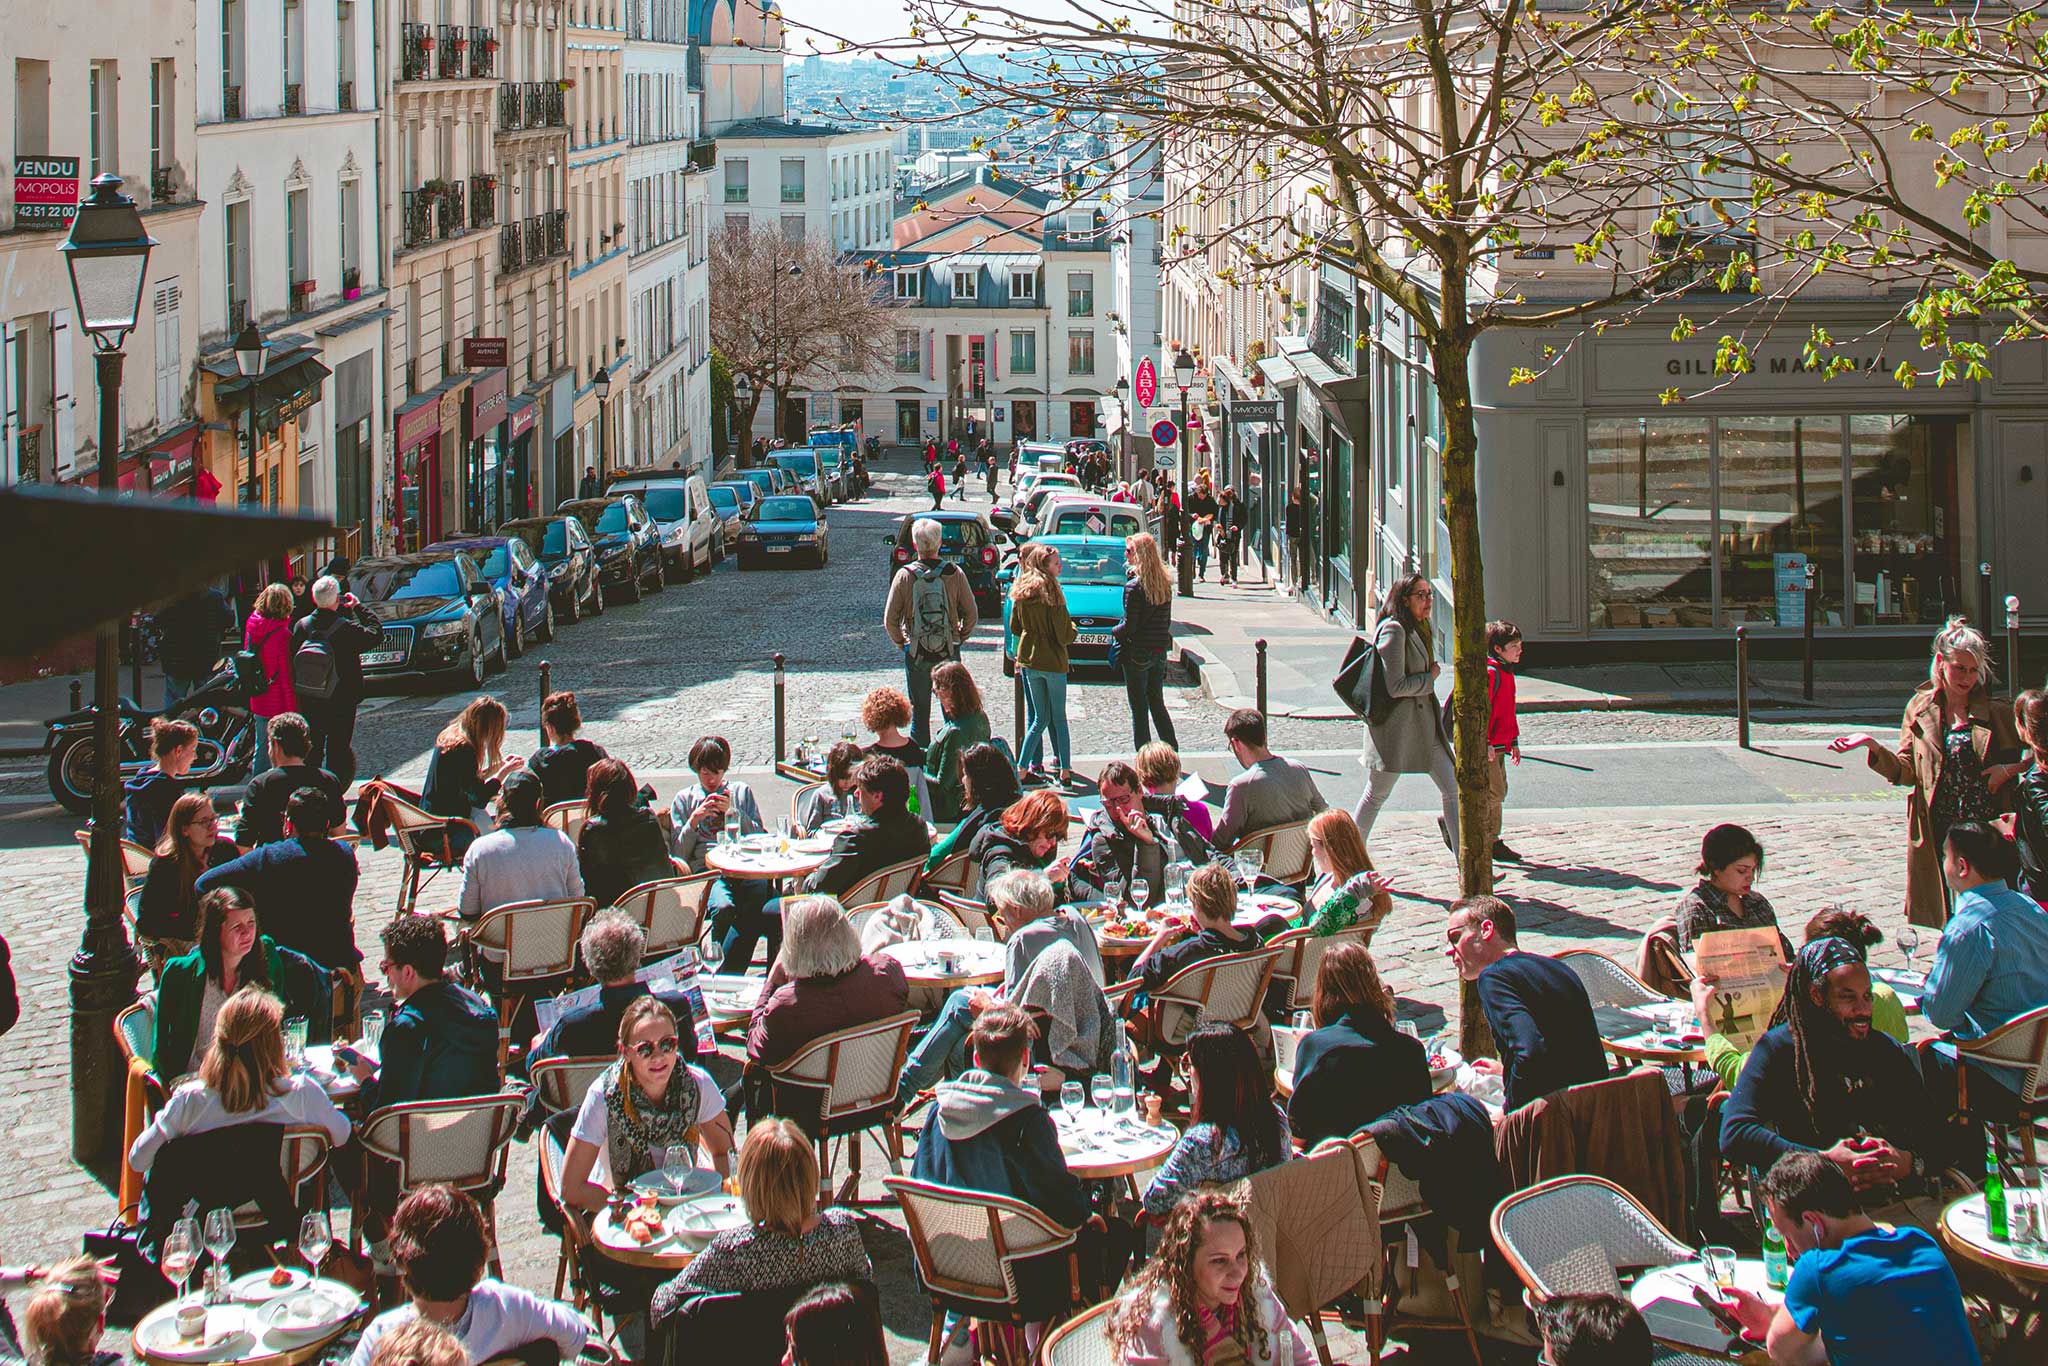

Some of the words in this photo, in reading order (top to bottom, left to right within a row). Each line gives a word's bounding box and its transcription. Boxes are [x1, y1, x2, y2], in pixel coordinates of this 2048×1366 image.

[19, 206, 32, 217] 42
[33, 206, 45, 217] 51
[48, 206, 61, 217] 22
[62, 206, 75, 217] 00
[1139, 360, 1153, 407] TABAC
